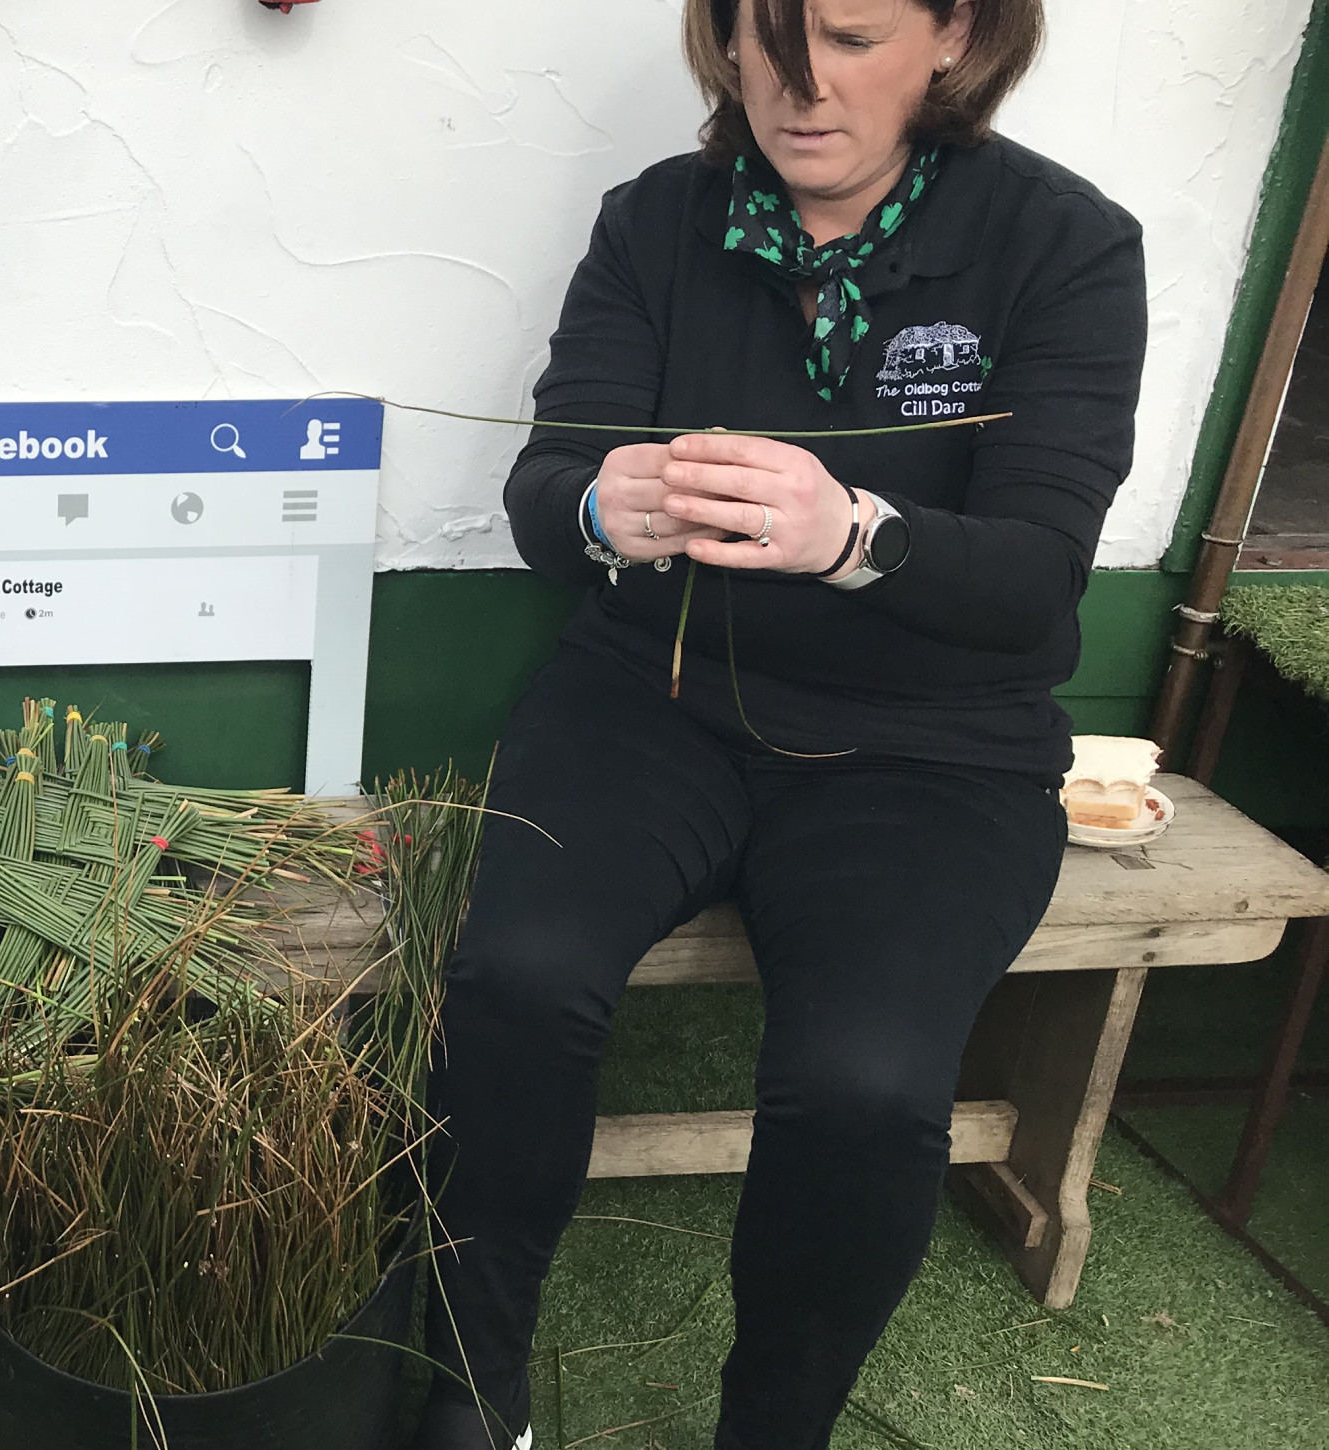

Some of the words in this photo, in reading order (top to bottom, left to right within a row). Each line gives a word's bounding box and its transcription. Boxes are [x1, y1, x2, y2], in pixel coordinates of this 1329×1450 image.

[875, 384, 901, 398] The
[904, 382, 949, 397] Oldbog
[900, 400, 928, 416] Cill
[931, 399, 966, 415] Dara
[1, 579, 63, 598] Cottage
[38, 609, 54, 619] 2m
